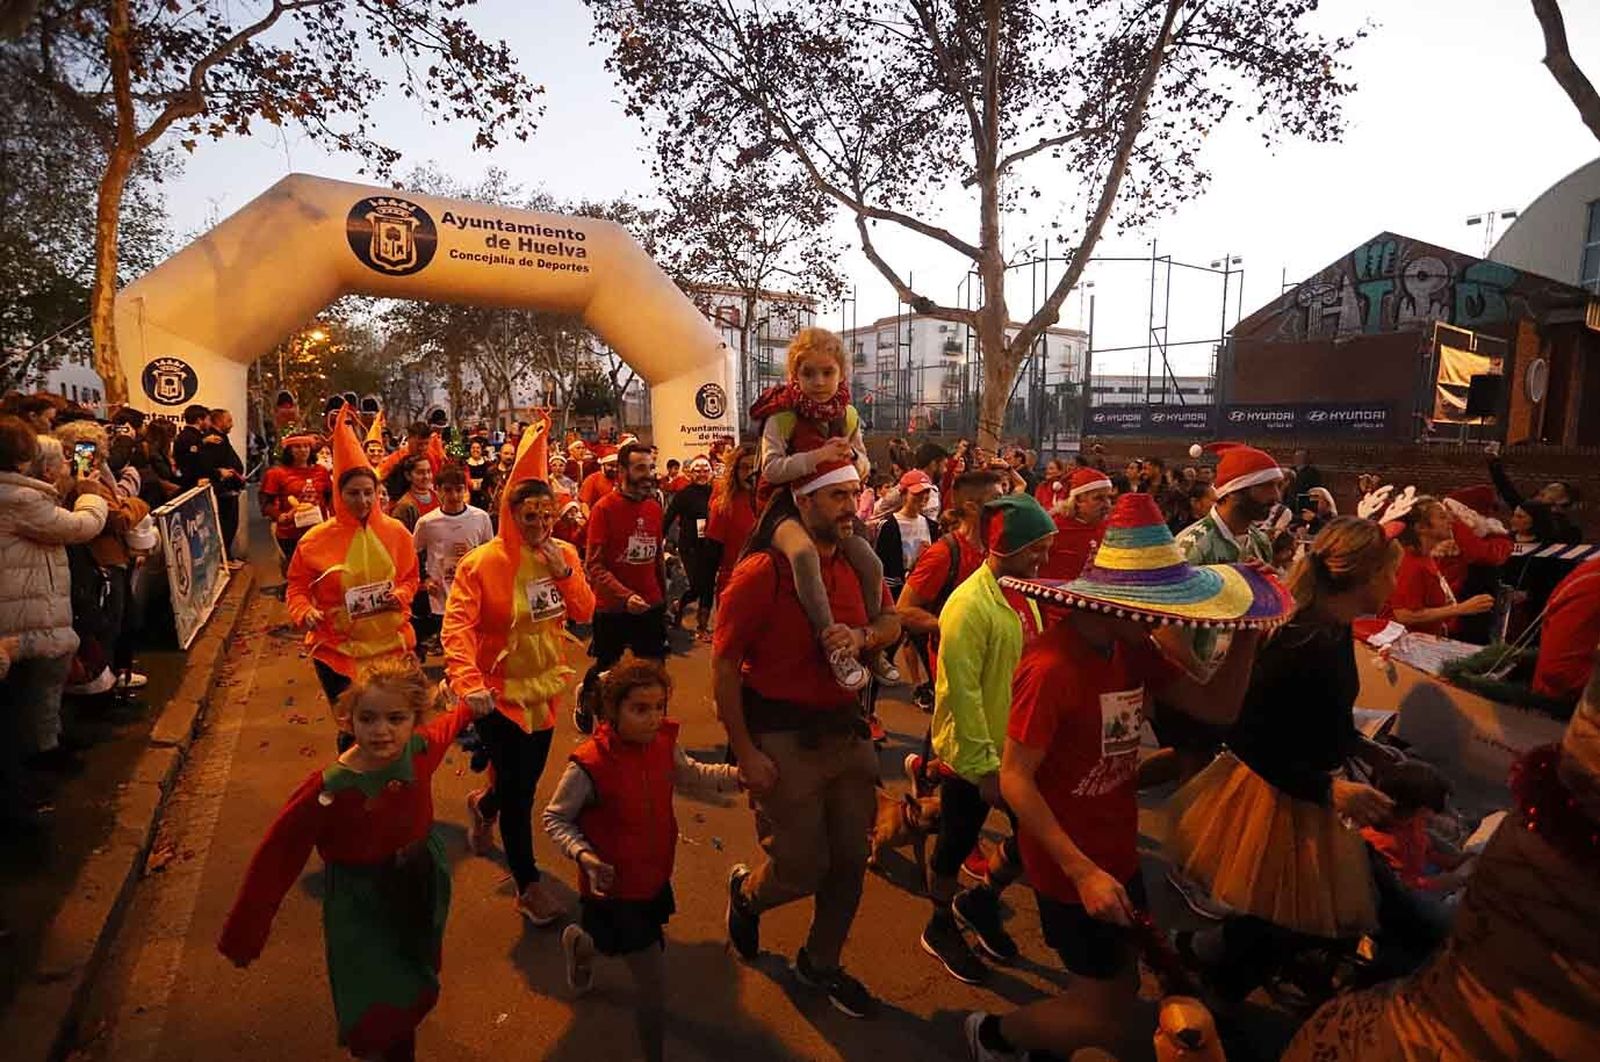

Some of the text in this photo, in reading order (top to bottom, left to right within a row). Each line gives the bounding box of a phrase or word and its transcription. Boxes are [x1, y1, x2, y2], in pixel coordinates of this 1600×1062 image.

[442, 211, 586, 241] Ayuntamiento
[485, 234, 587, 258] de Huelva
[519, 257, 533, 267] de
[537, 259, 590, 273] Deportes
[1106, 413, 1141, 422] HYUNDAI
[1166, 412, 1207, 421] HYUNDAI
[1246, 411, 1294, 421] HYUNDAI
[1329, 410, 1385, 421] HYUNDAI
